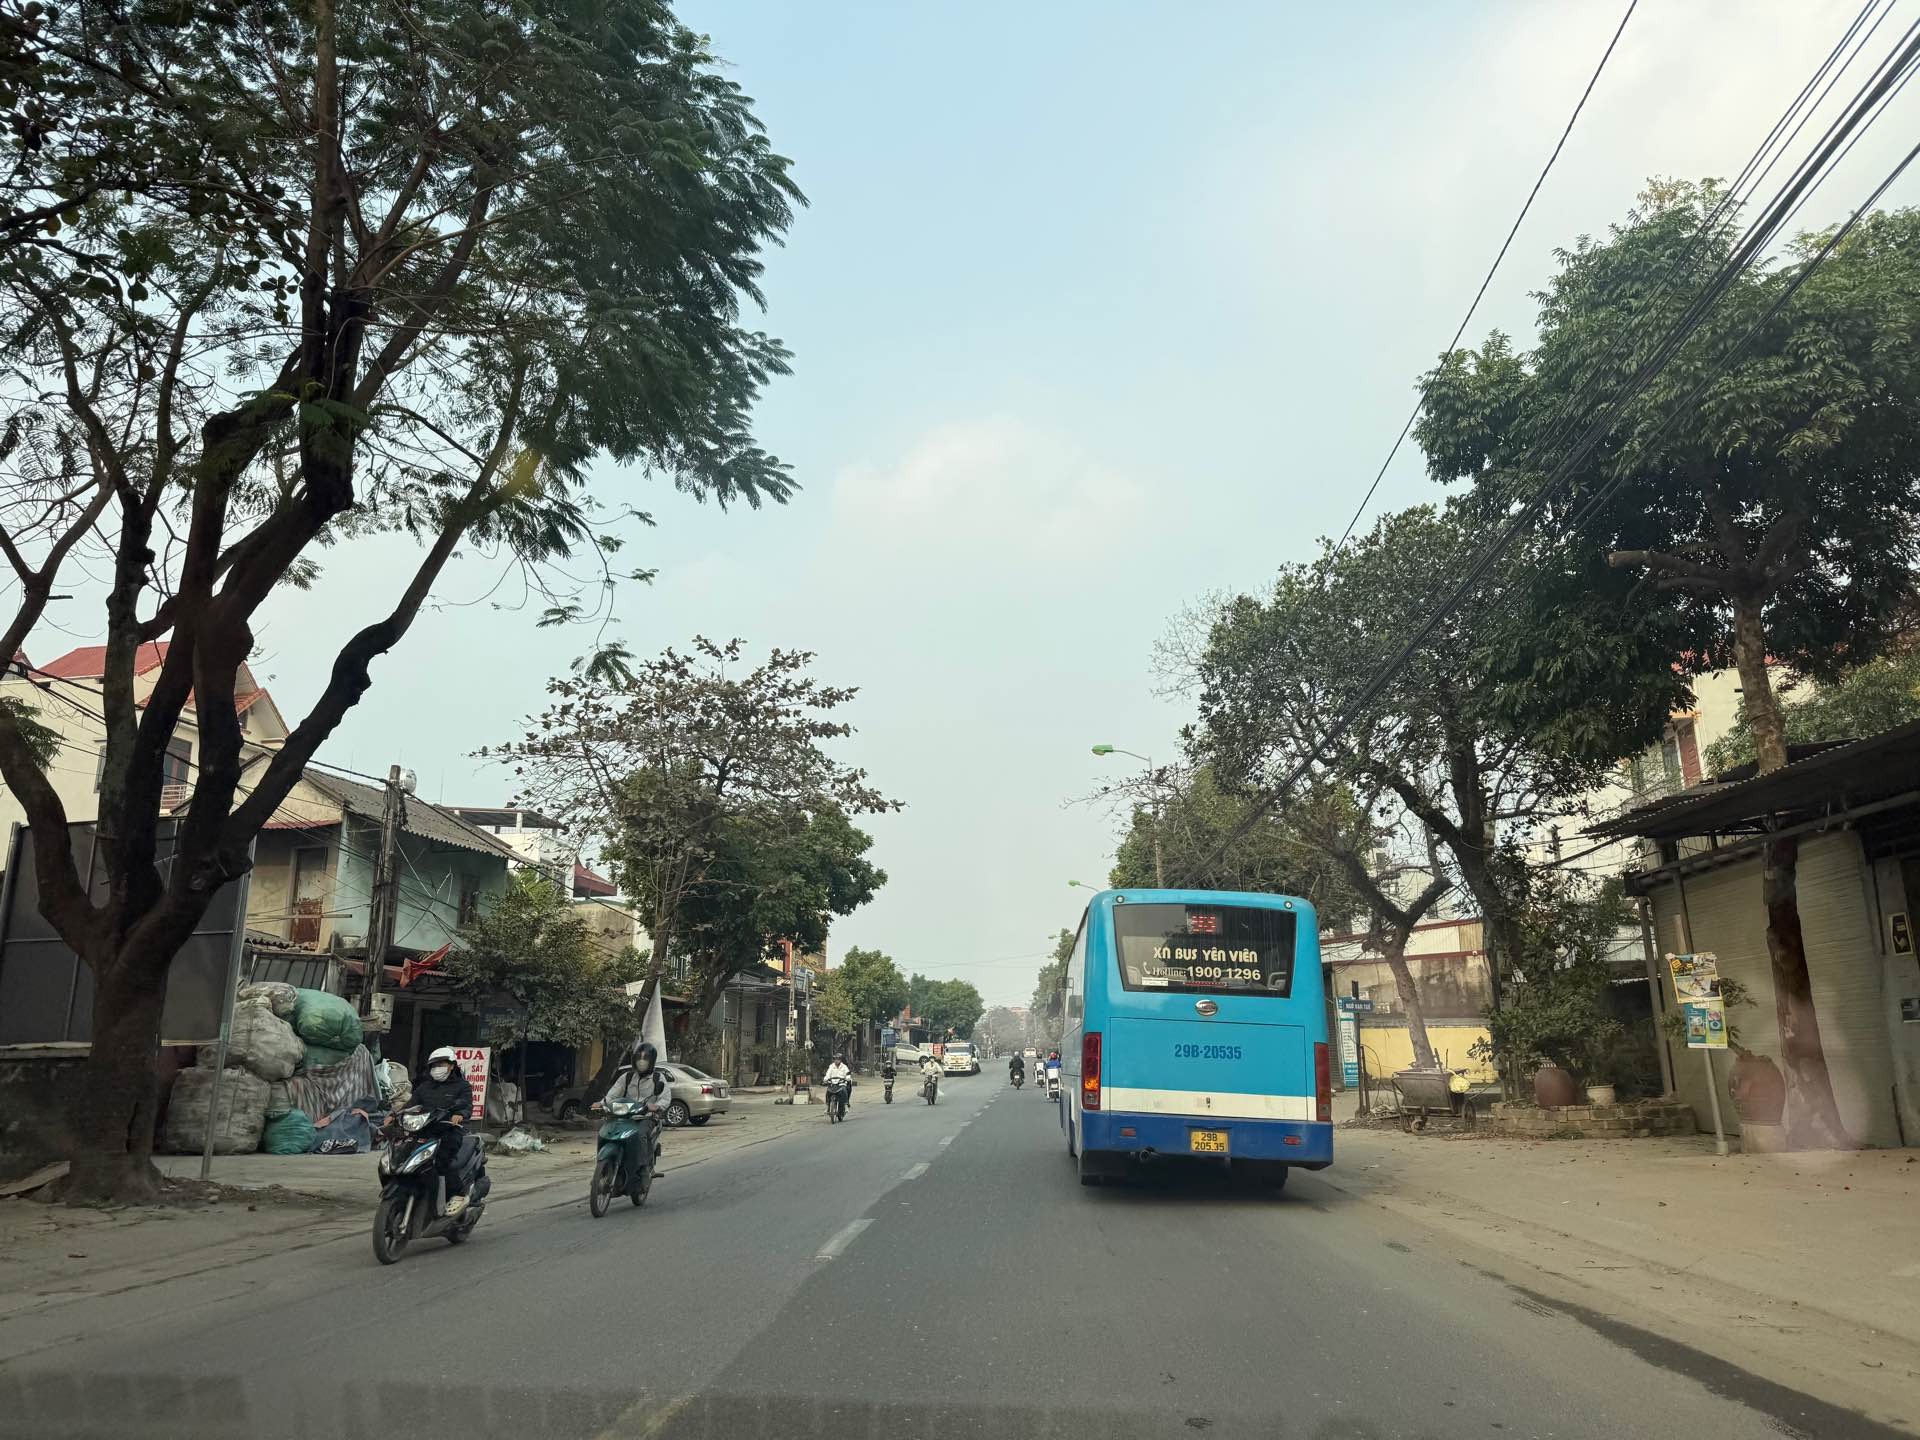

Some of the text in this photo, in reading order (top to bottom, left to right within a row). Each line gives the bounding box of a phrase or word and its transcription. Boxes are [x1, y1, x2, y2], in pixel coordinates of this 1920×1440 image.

[1175, 948, 1198, 961] BUS
[1202, 946, 1227, 962] YÊN
[1229, 947, 1258, 963] VIÊN
[1188, 966, 1222, 978] 1900
[1227, 968, 1261, 981] 1296
[1175, 1044, 1242, 1059] 29B-20535
[1201, 1132, 1217, 1141] 29B
[1194, 1142, 1225, 1151] 205.35
